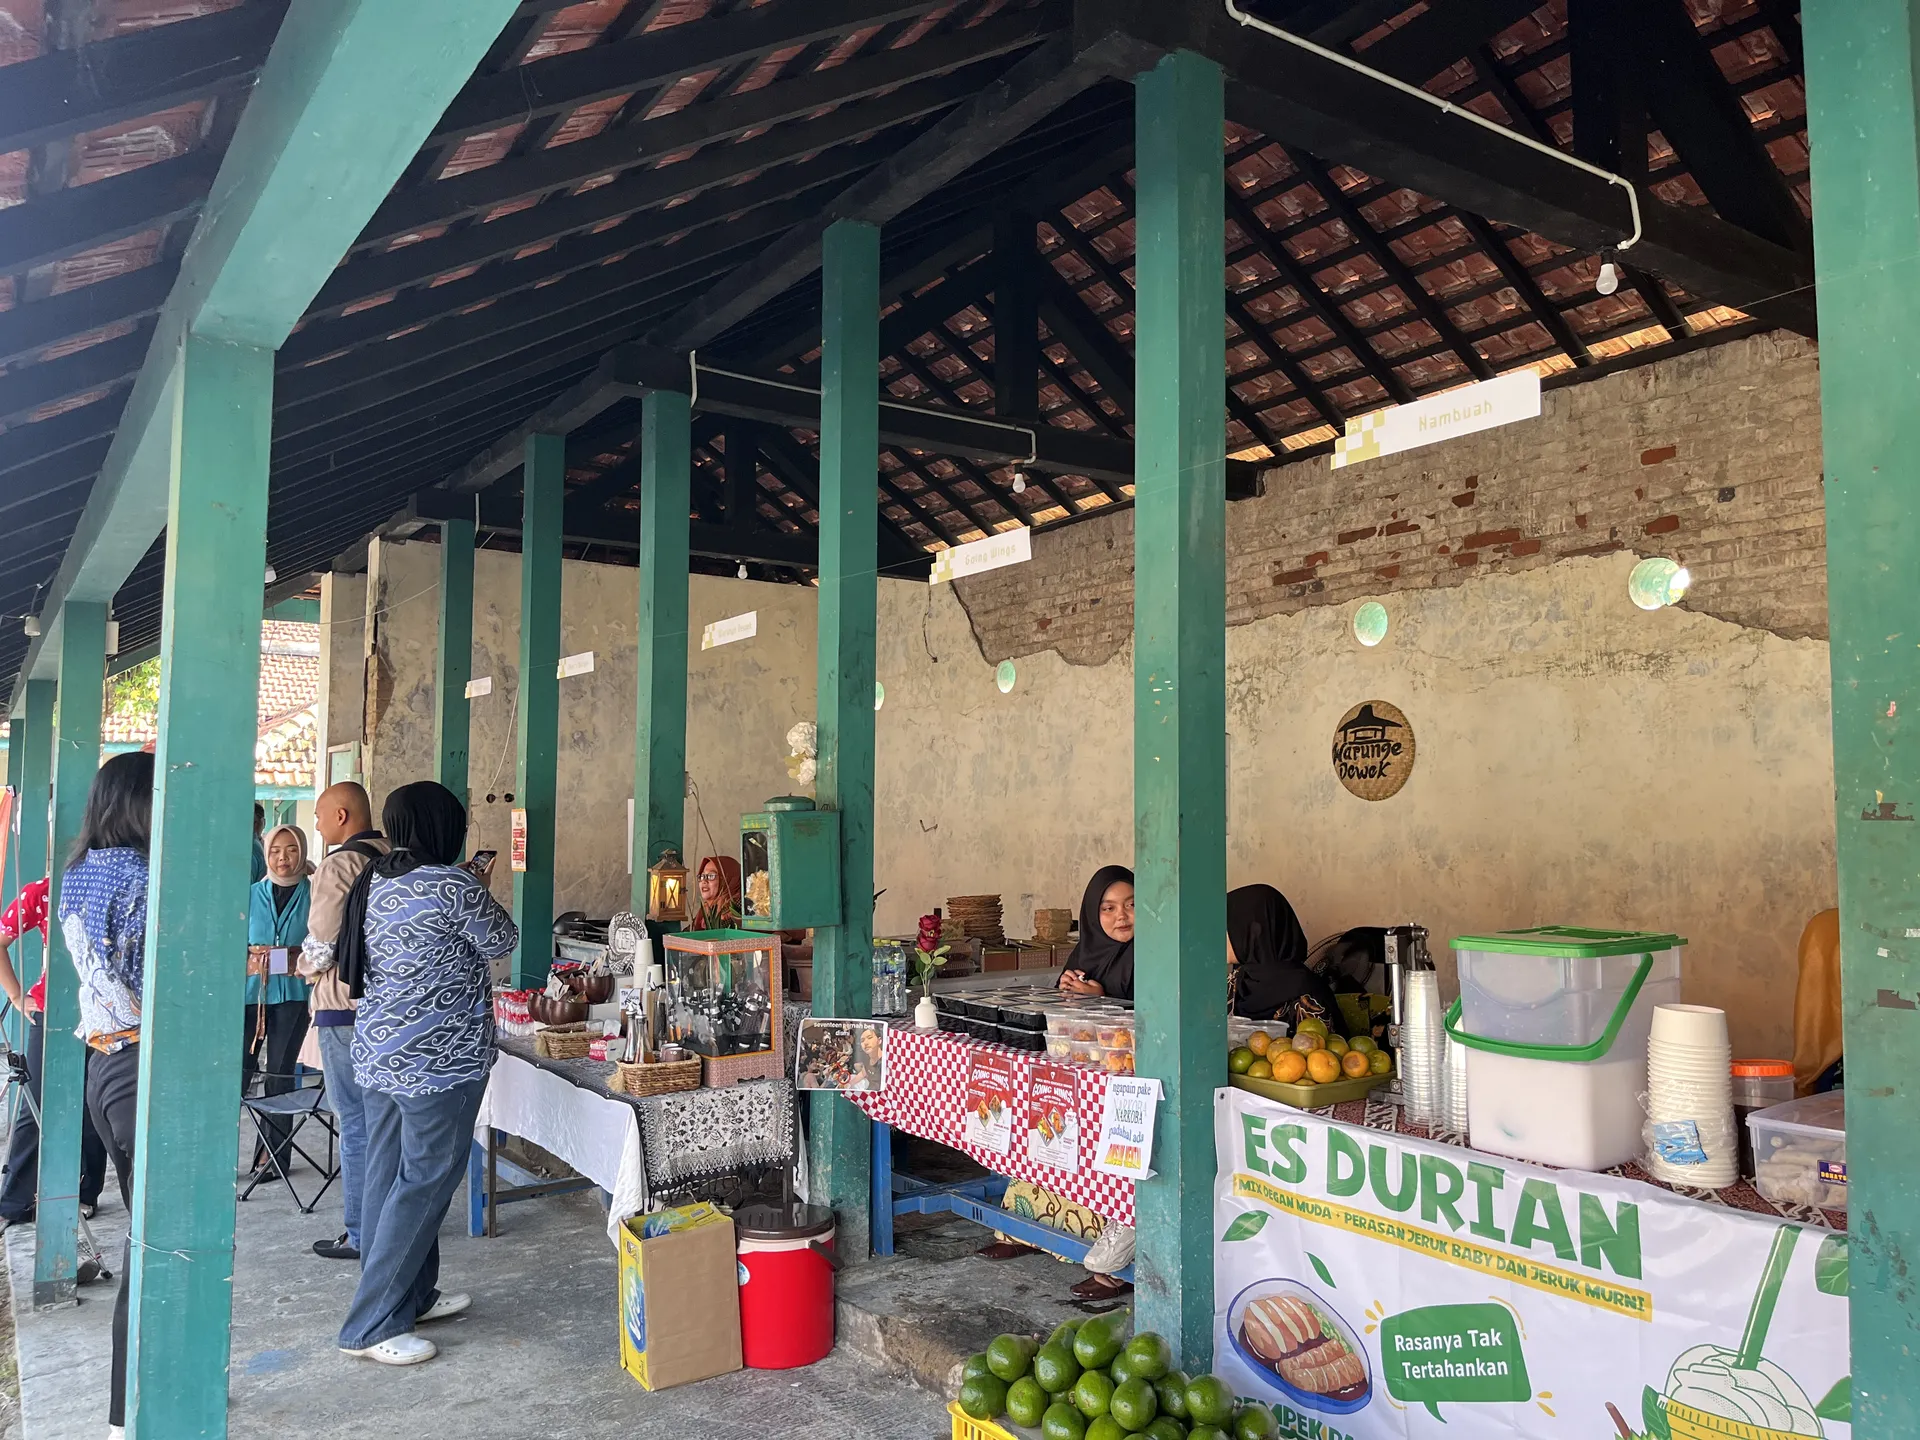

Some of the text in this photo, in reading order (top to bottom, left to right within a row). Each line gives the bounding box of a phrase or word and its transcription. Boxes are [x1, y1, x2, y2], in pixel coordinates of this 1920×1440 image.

[1418, 399, 1493, 432] Nambuah
[1332, 742, 1404, 766] Warunge
[1112, 1081, 1152, 1098] ngapain pake
[1108, 1125, 1144, 1143] padahal ada
[1240, 1111, 1643, 1281] ES DURIAN
[1238, 1179, 1264, 1195] MIX
[1263, 1186, 1294, 1210] DEGAN
[1296, 1198, 1332, 1219] MUDA
[1344, 1211, 1406, 1241] PERASAN
[1407, 1229, 1449, 1255] JERUK
[1451, 1244, 1493, 1268] BABY
[1496, 1256, 1528, 1278] DAN
[1531, 1266, 1581, 1295] JERUK
[1585, 1283, 1645, 1312] MURNI
[1394, 1327, 1503, 1354] Rasanya Tak
[1401, 1357, 1508, 1379] Tertahankan
